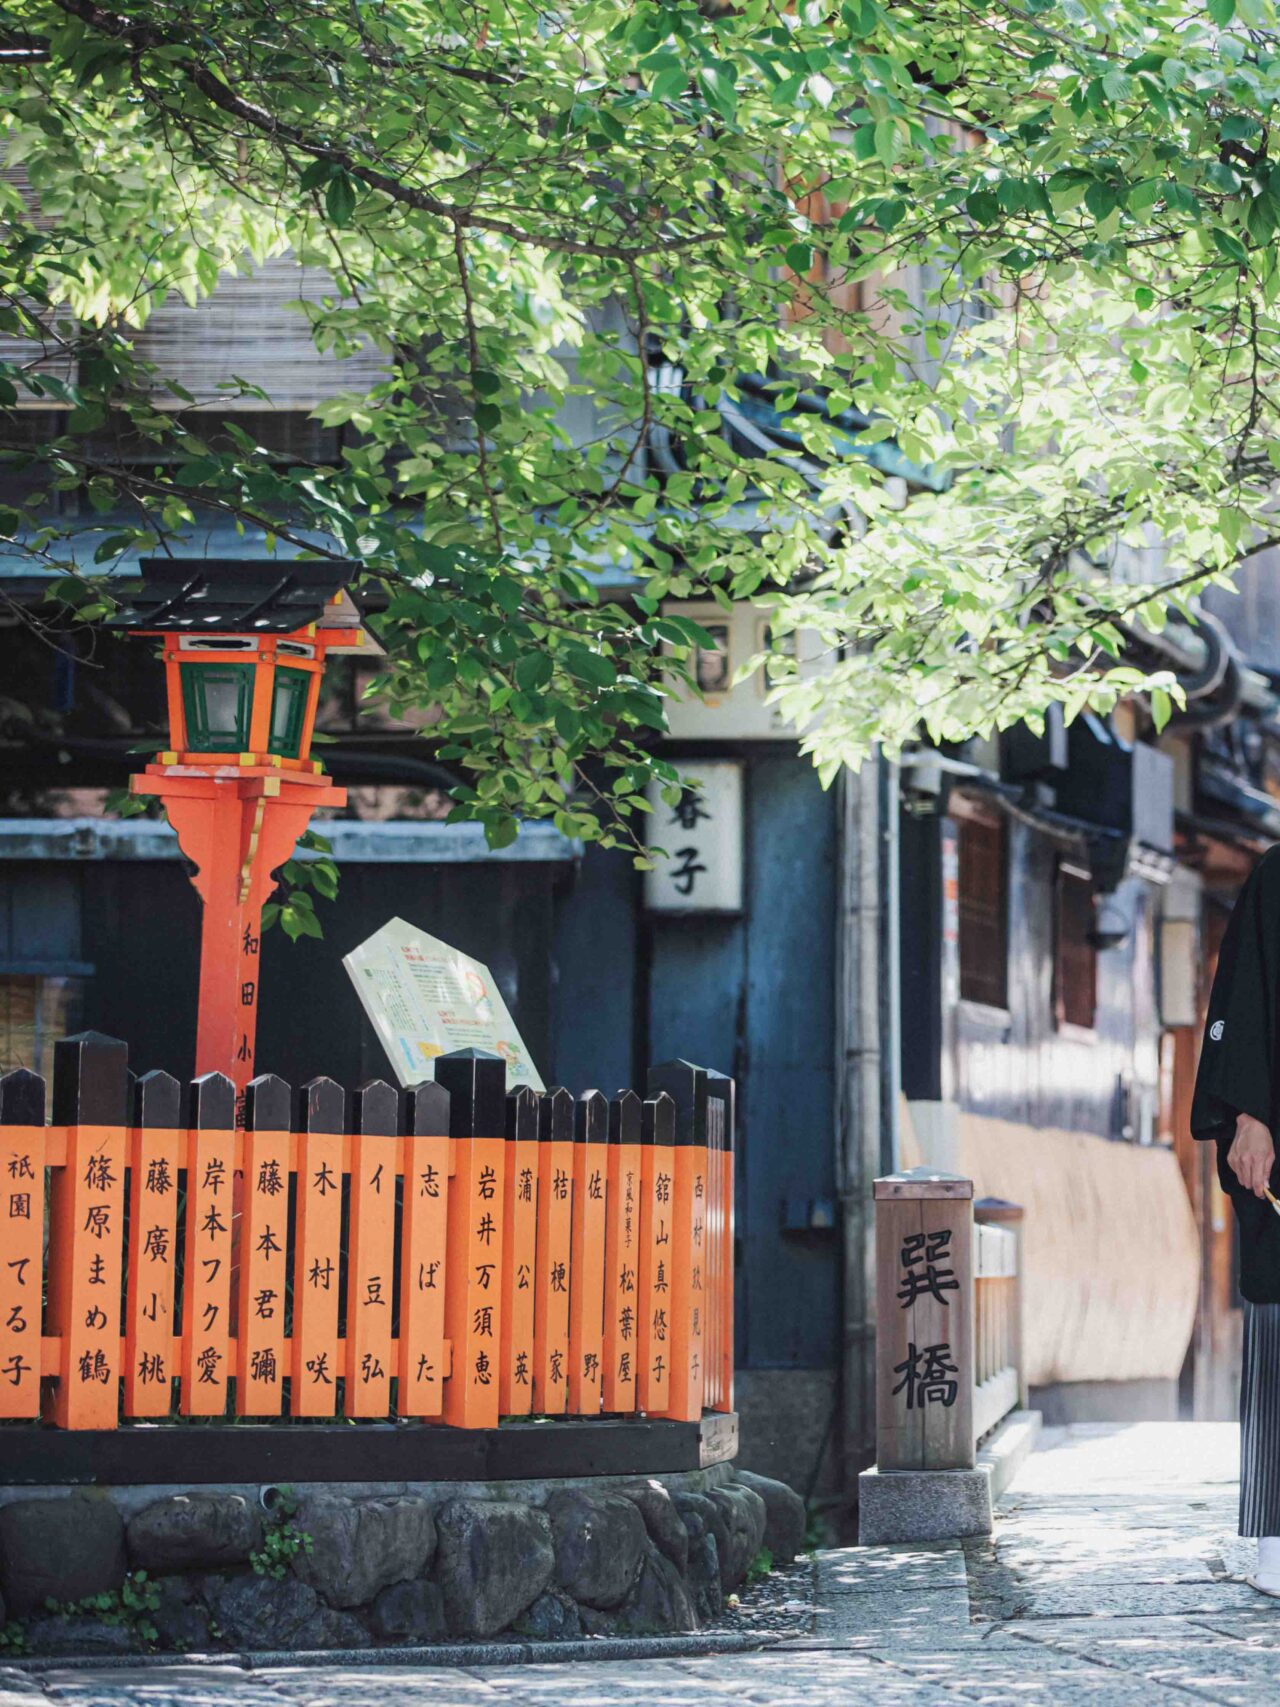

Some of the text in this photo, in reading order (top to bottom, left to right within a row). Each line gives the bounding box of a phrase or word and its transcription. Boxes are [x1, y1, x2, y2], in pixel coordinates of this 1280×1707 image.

[234, 922, 259, 1179] 和田小富
[78, 1154, 117, 1385] 篠原まめ鶴
[138, 1157, 174, 1385] 藤廣小桃
[197, 1157, 228, 1385] 岸本フク愛
[250, 1159, 285, 1384] 藤本君彌
[305, 1161, 338, 1385] 木村咲
[416, 1164, 440, 1383] 志ばた
[473, 1164, 497, 1386] 岩井万須恵
[513, 1167, 533, 1386] 蒲公英
[549, 1168, 569, 1383] 桔梗家
[583, 1170, 604, 1385] 佐野
[618, 1262, 635, 1383] 松葉屋
[652, 1171, 671, 1384] 舘山真悠子
[891, 1229, 960, 1410] 巽橋
